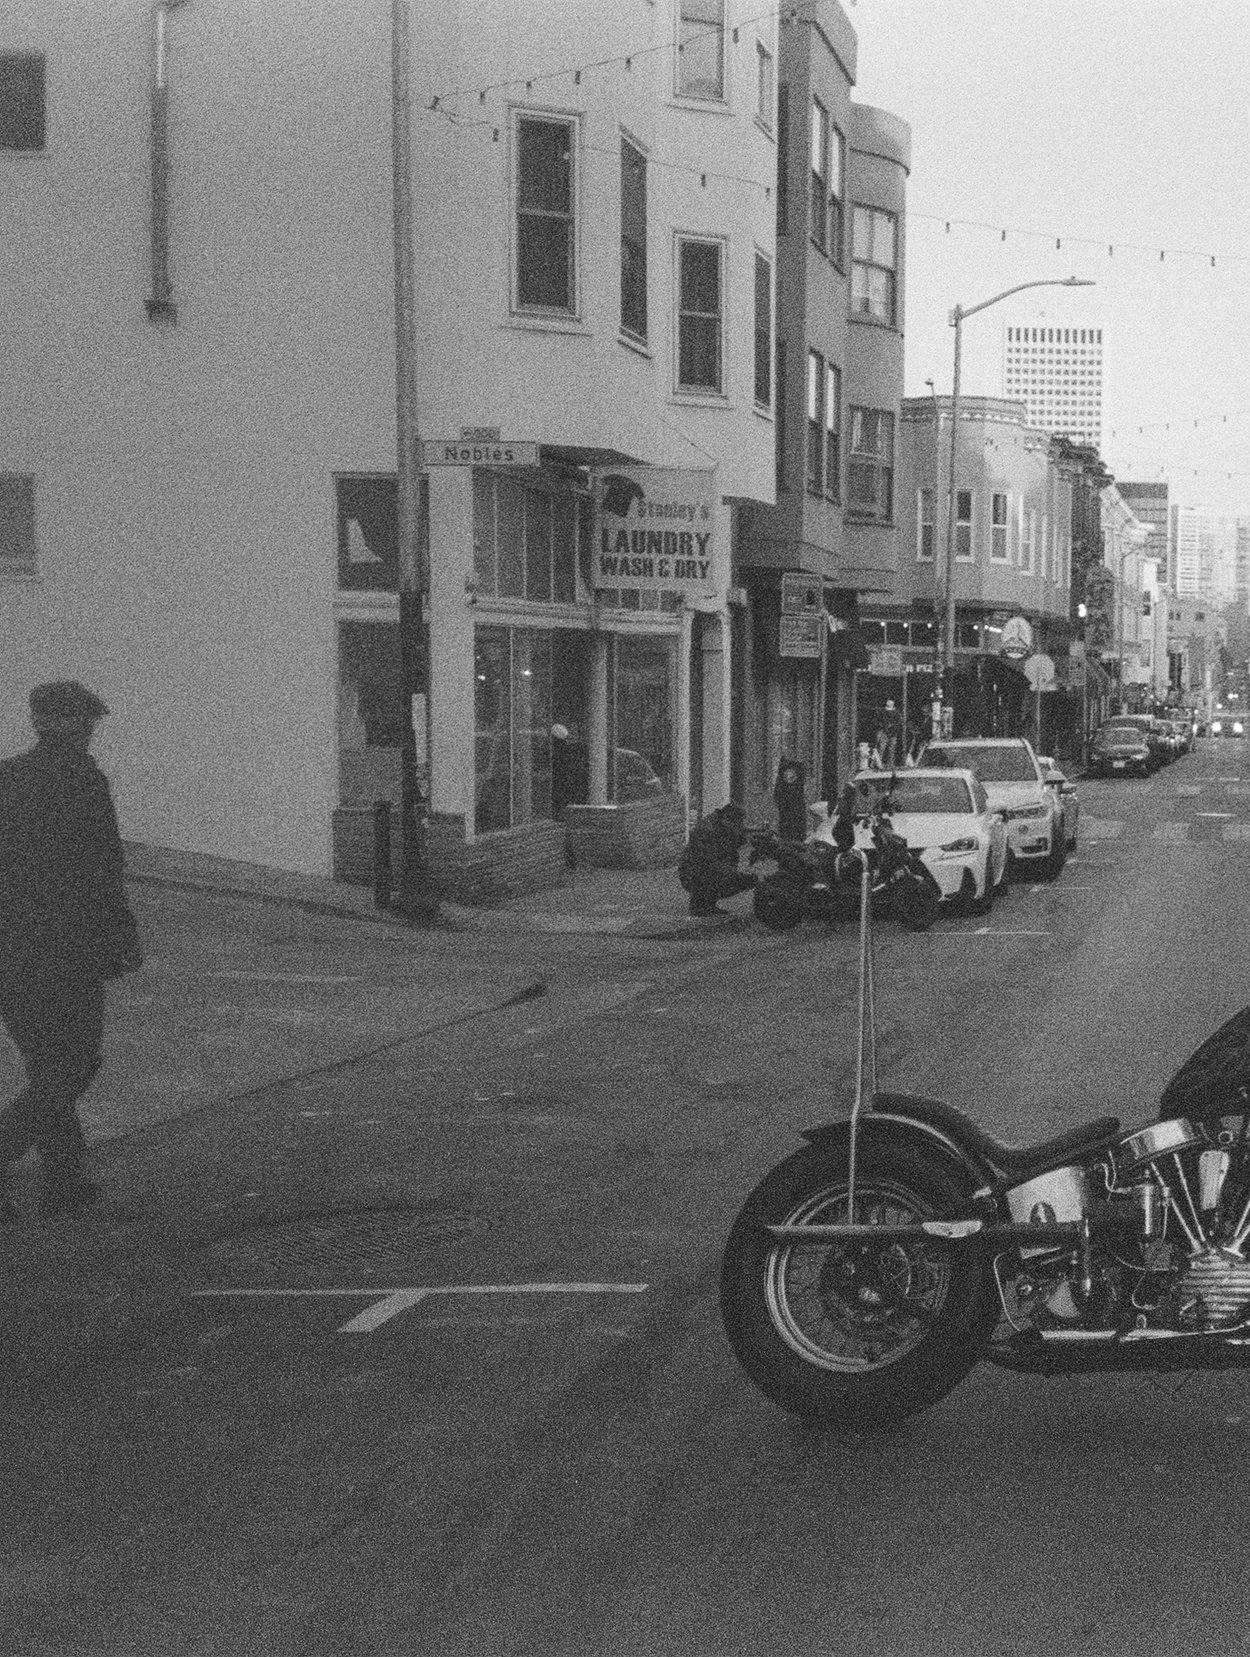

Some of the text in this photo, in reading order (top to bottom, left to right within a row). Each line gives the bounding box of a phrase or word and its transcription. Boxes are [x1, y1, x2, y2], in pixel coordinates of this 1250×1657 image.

[444, 446, 515, 462] Nobles
[637, 499, 711, 522] Stanley's
[601, 528, 711, 557] LAUNDRY
[599, 556, 655, 578] WASH
[675, 559, 711, 580] DRY
